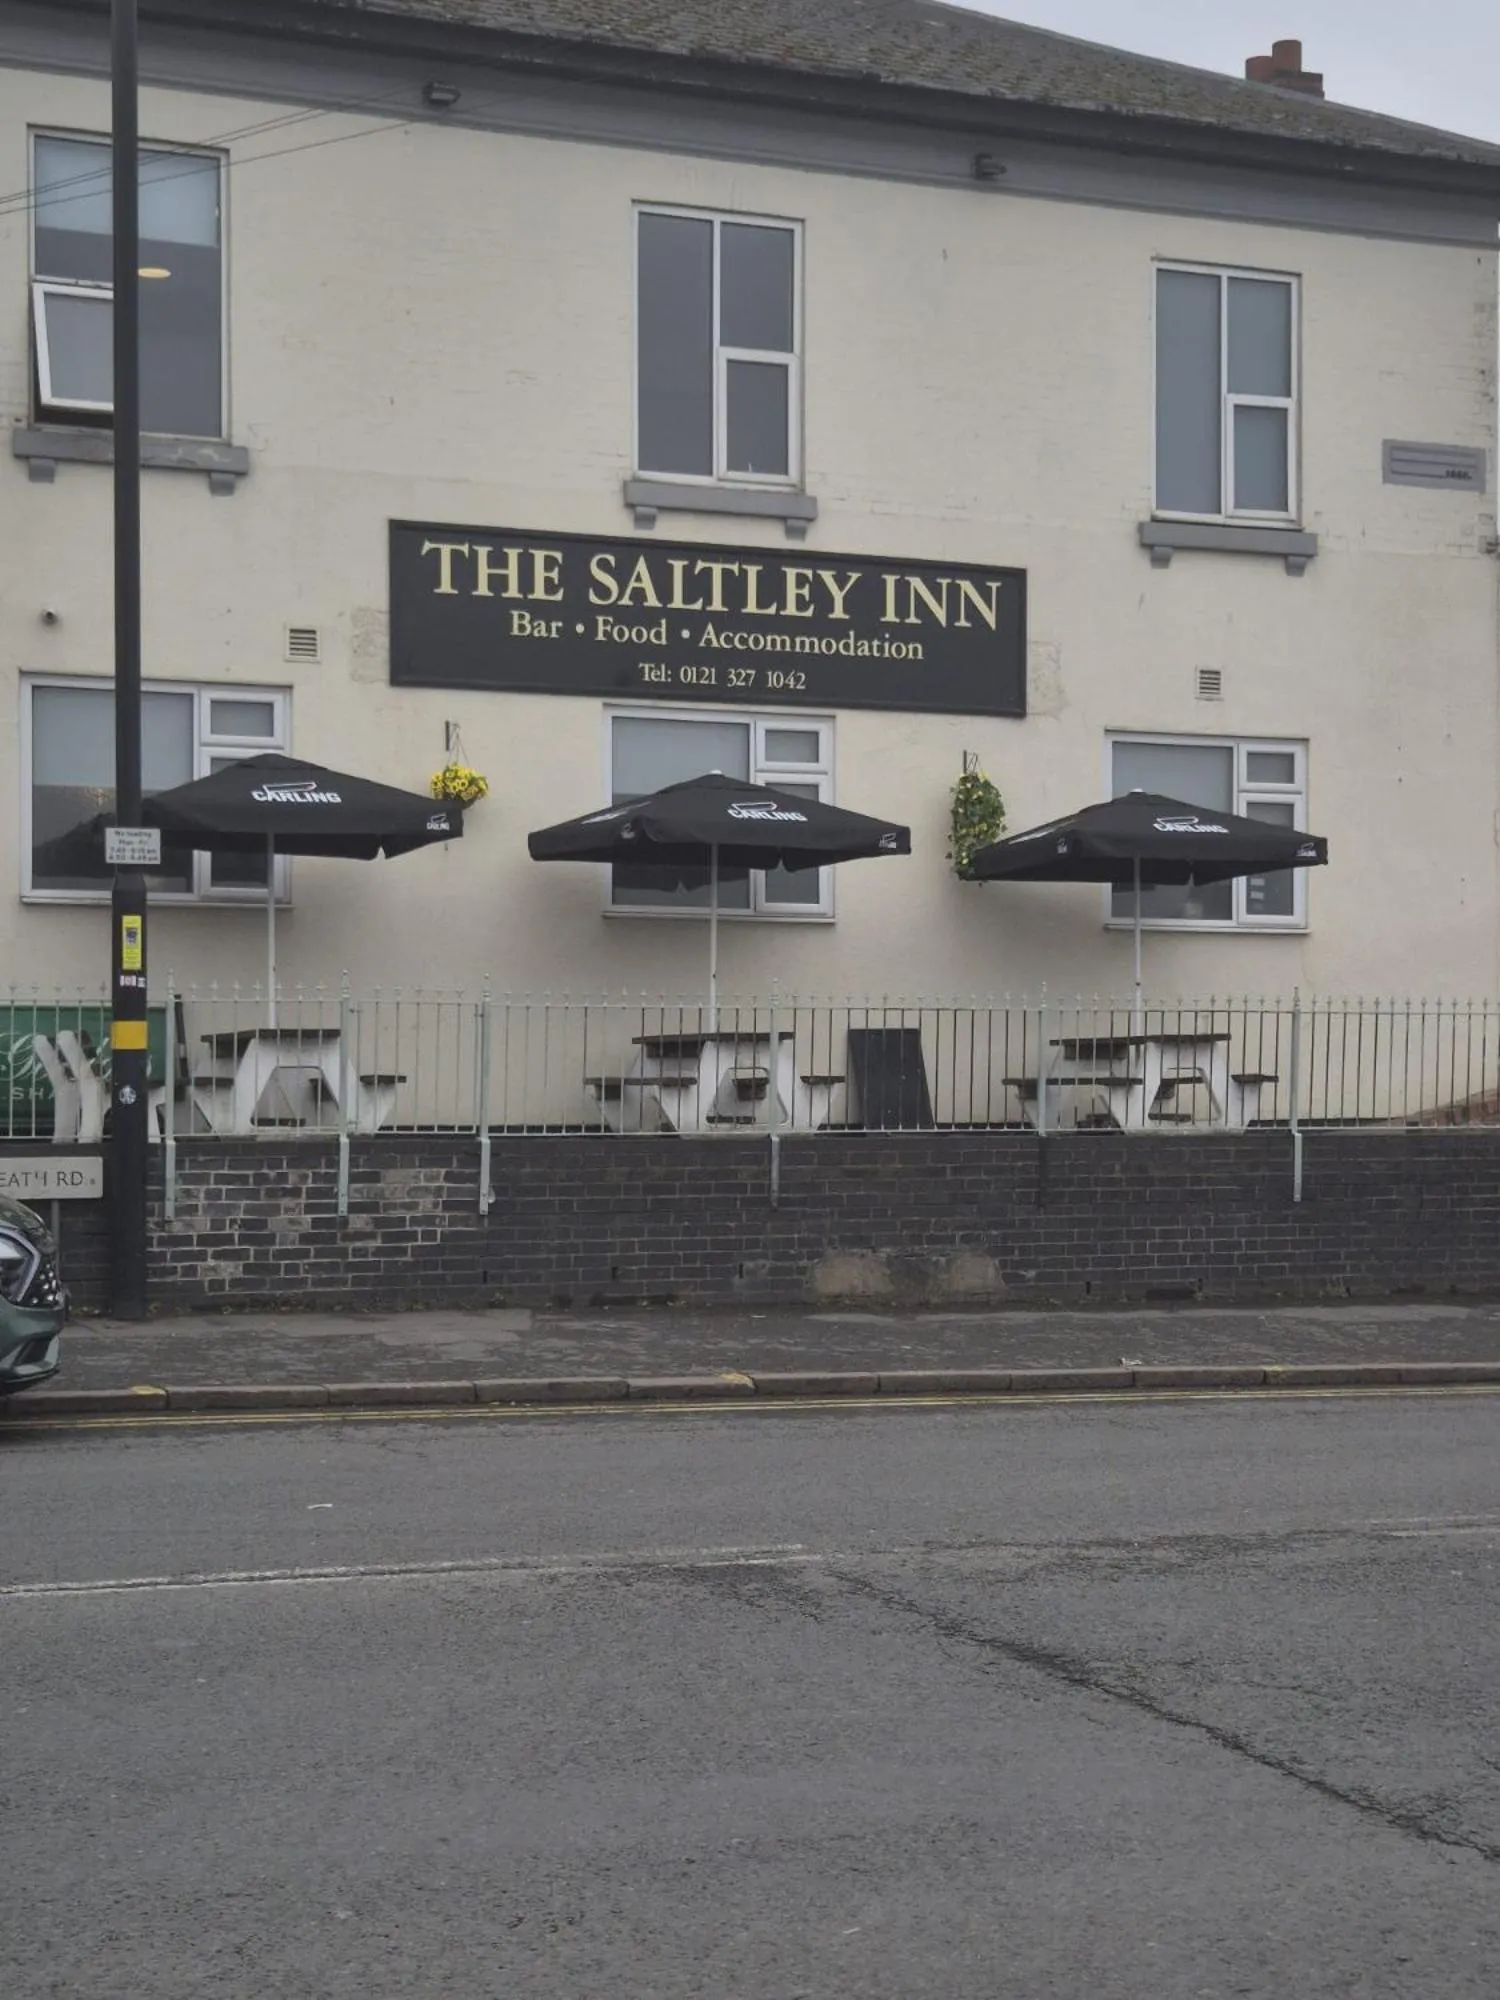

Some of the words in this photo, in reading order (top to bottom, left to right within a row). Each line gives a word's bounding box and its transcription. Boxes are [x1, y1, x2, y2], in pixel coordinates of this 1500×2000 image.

[420, 539, 564, 601] THE
[588, 553, 862, 619] SALTLEY
[880, 574, 1001, 631] INN
[510, 610, 563, 638] Bar
[595, 615, 668, 645] Food
[699, 622, 924, 660] Accommodation
[638, 662, 672, 682] Tel:
[680, 666, 717, 685] 0121
[726, 667, 756, 687] 327
[767, 671, 806, 690] 1042
[252, 788, 342, 804] CARLING
[727, 807, 808, 822] CARLING
[56, 1171, 83, 1187] RD
